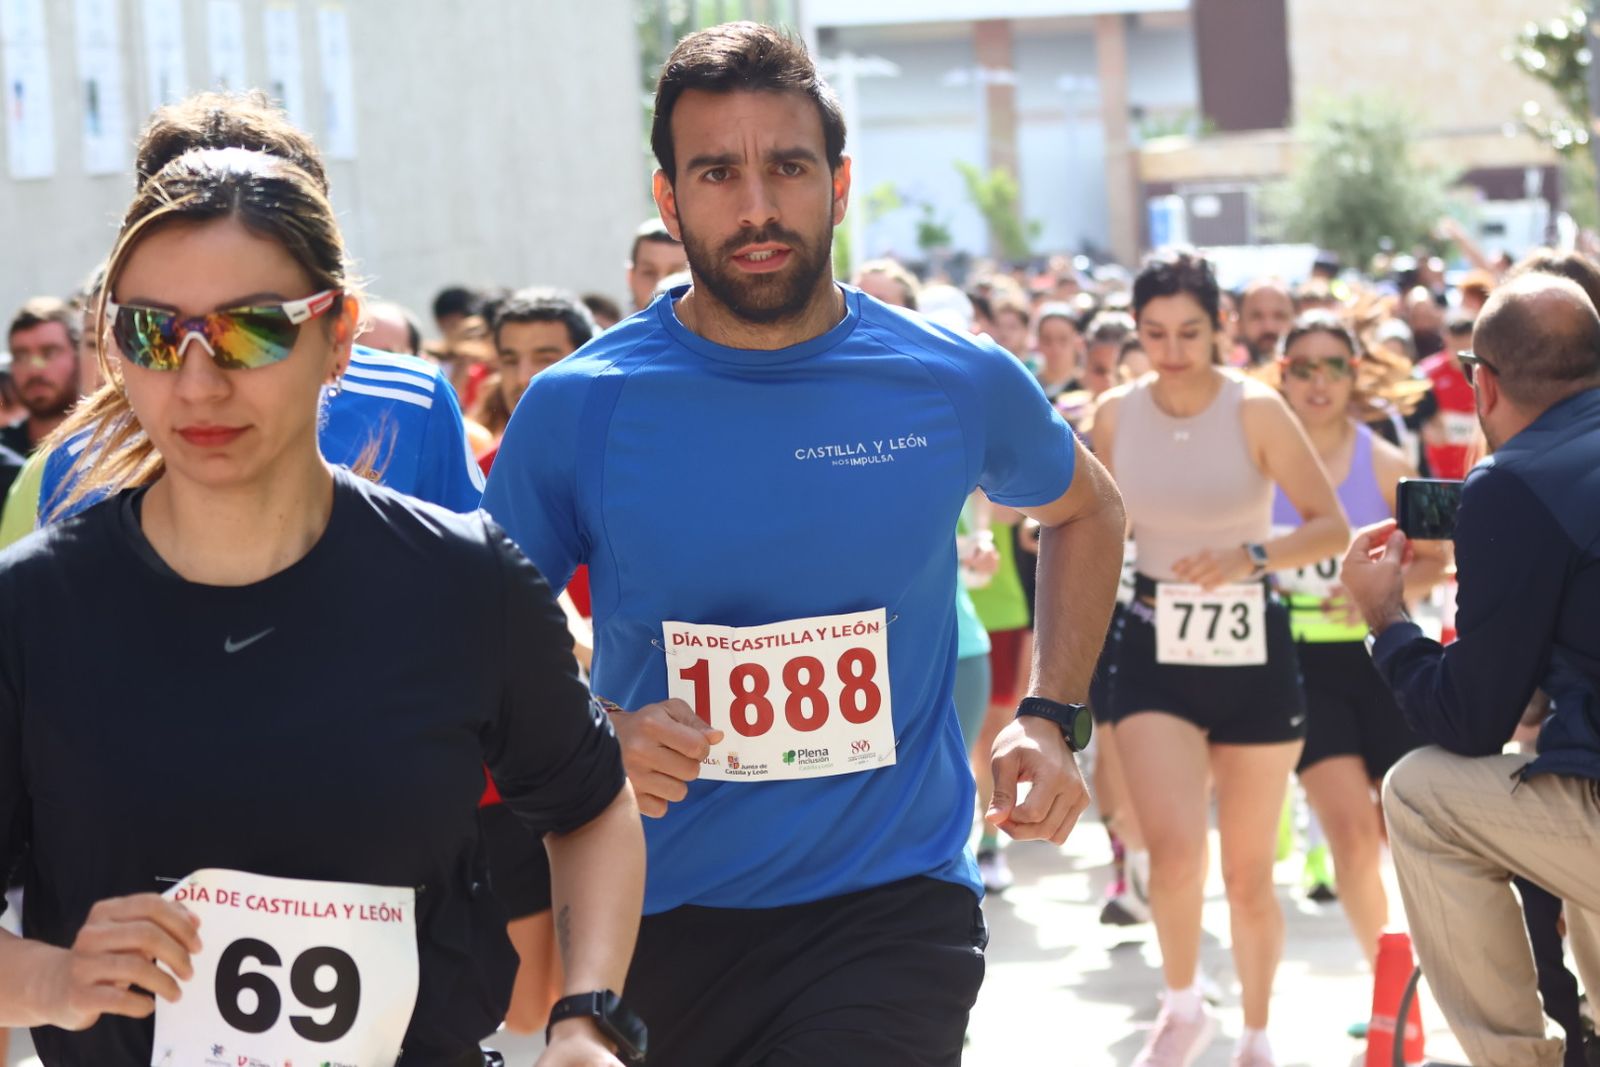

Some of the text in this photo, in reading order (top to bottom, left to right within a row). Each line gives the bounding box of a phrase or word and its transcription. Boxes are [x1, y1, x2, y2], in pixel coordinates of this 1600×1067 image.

[795, 433, 928, 460] CASTILLA Y LEÓN
[672, 620, 880, 652] DÍA DE CASTILLA Y LEÓN
[1172, 602, 1251, 641] 773
[679, 646, 882, 738] 1888
[797, 748, 829, 759] Plena
[798, 756, 830, 765] inclusión
[174, 884, 402, 922] DÍA DE CASTILLA Y LEÓN
[214, 937, 361, 1043] 69
